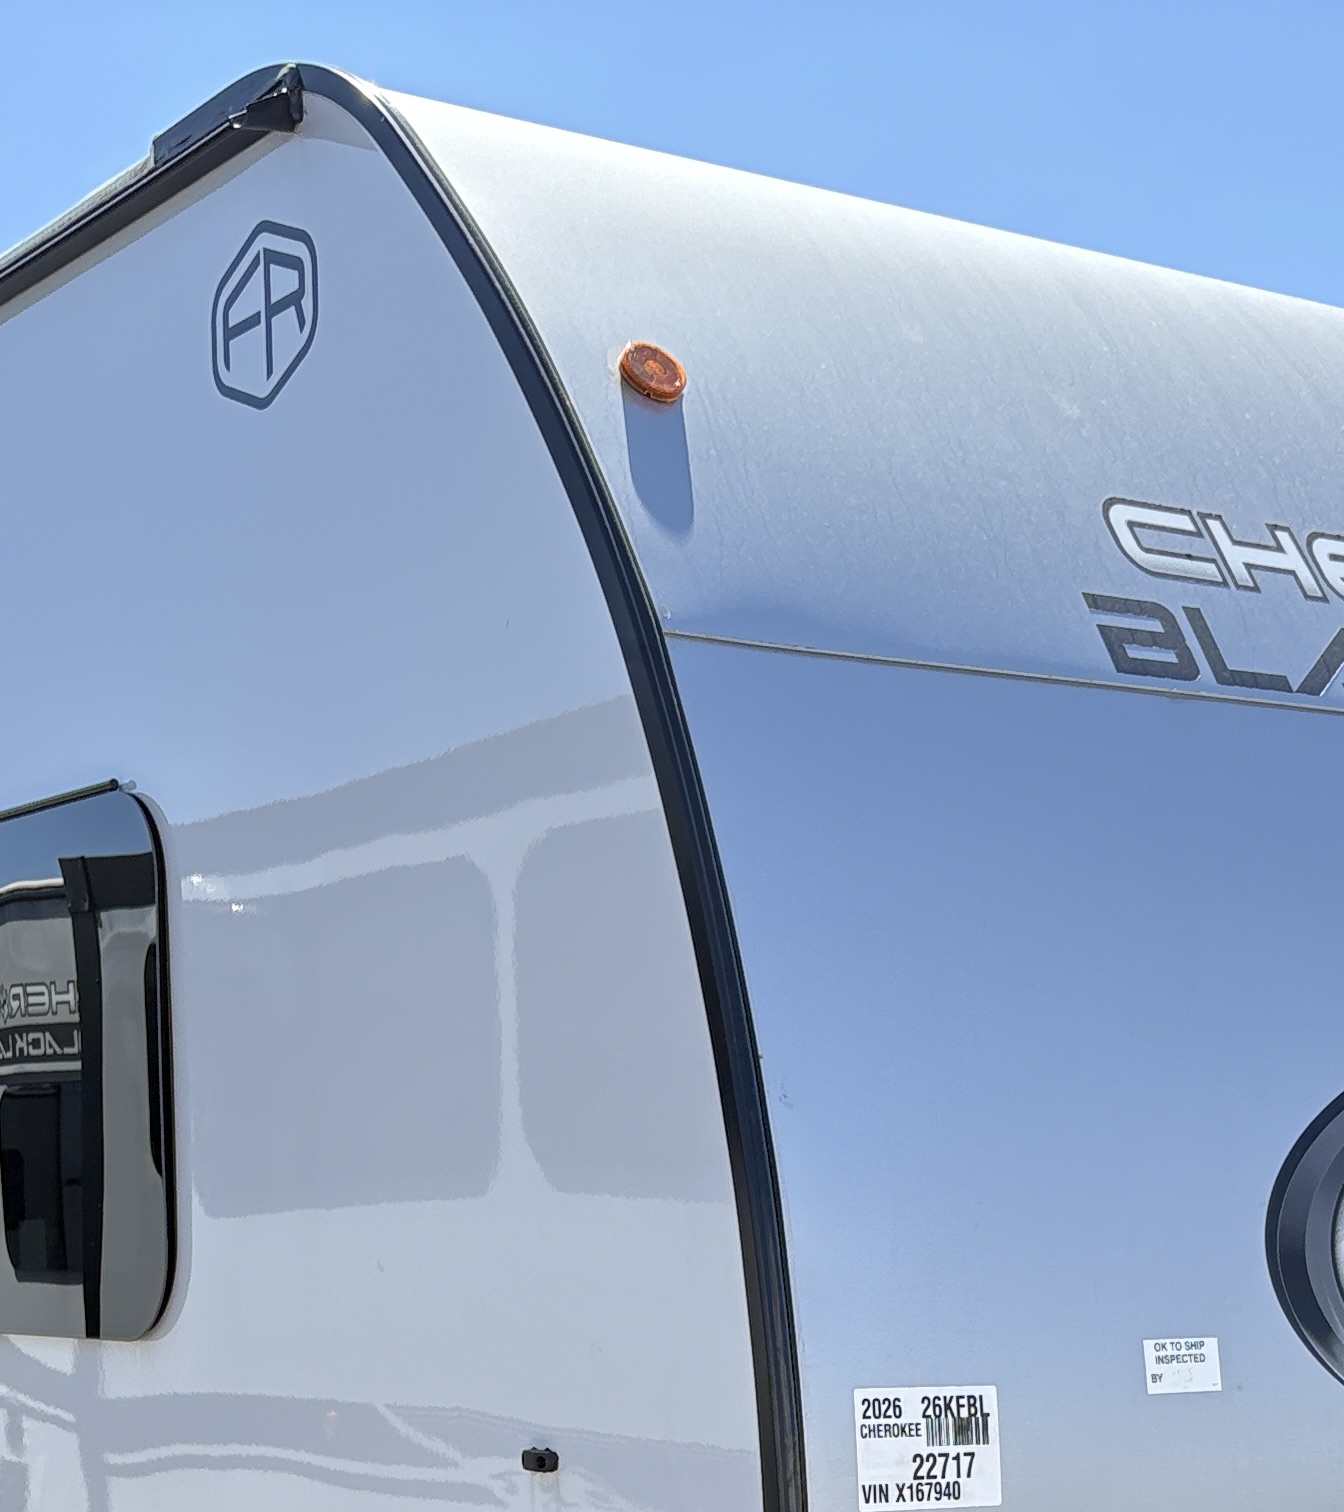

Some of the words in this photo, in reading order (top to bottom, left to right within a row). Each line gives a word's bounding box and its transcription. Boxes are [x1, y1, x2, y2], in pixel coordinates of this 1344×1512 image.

[1153, 1341, 1168, 1352] OK
[1169, 1341, 1182, 1352] TO
[1184, 1340, 1205, 1351] SHIP
[1155, 1353, 1206, 1365] INSPECTED
[1150, 1373, 1163, 1383] BY
[861, 1397, 902, 1419] 2026
[860, 1422, 922, 1439] CHEROKEE
[912, 1452, 975, 1480] 22717
[861, 1483, 889, 1504] VIN
[895, 1480, 961, 1503] X167940
